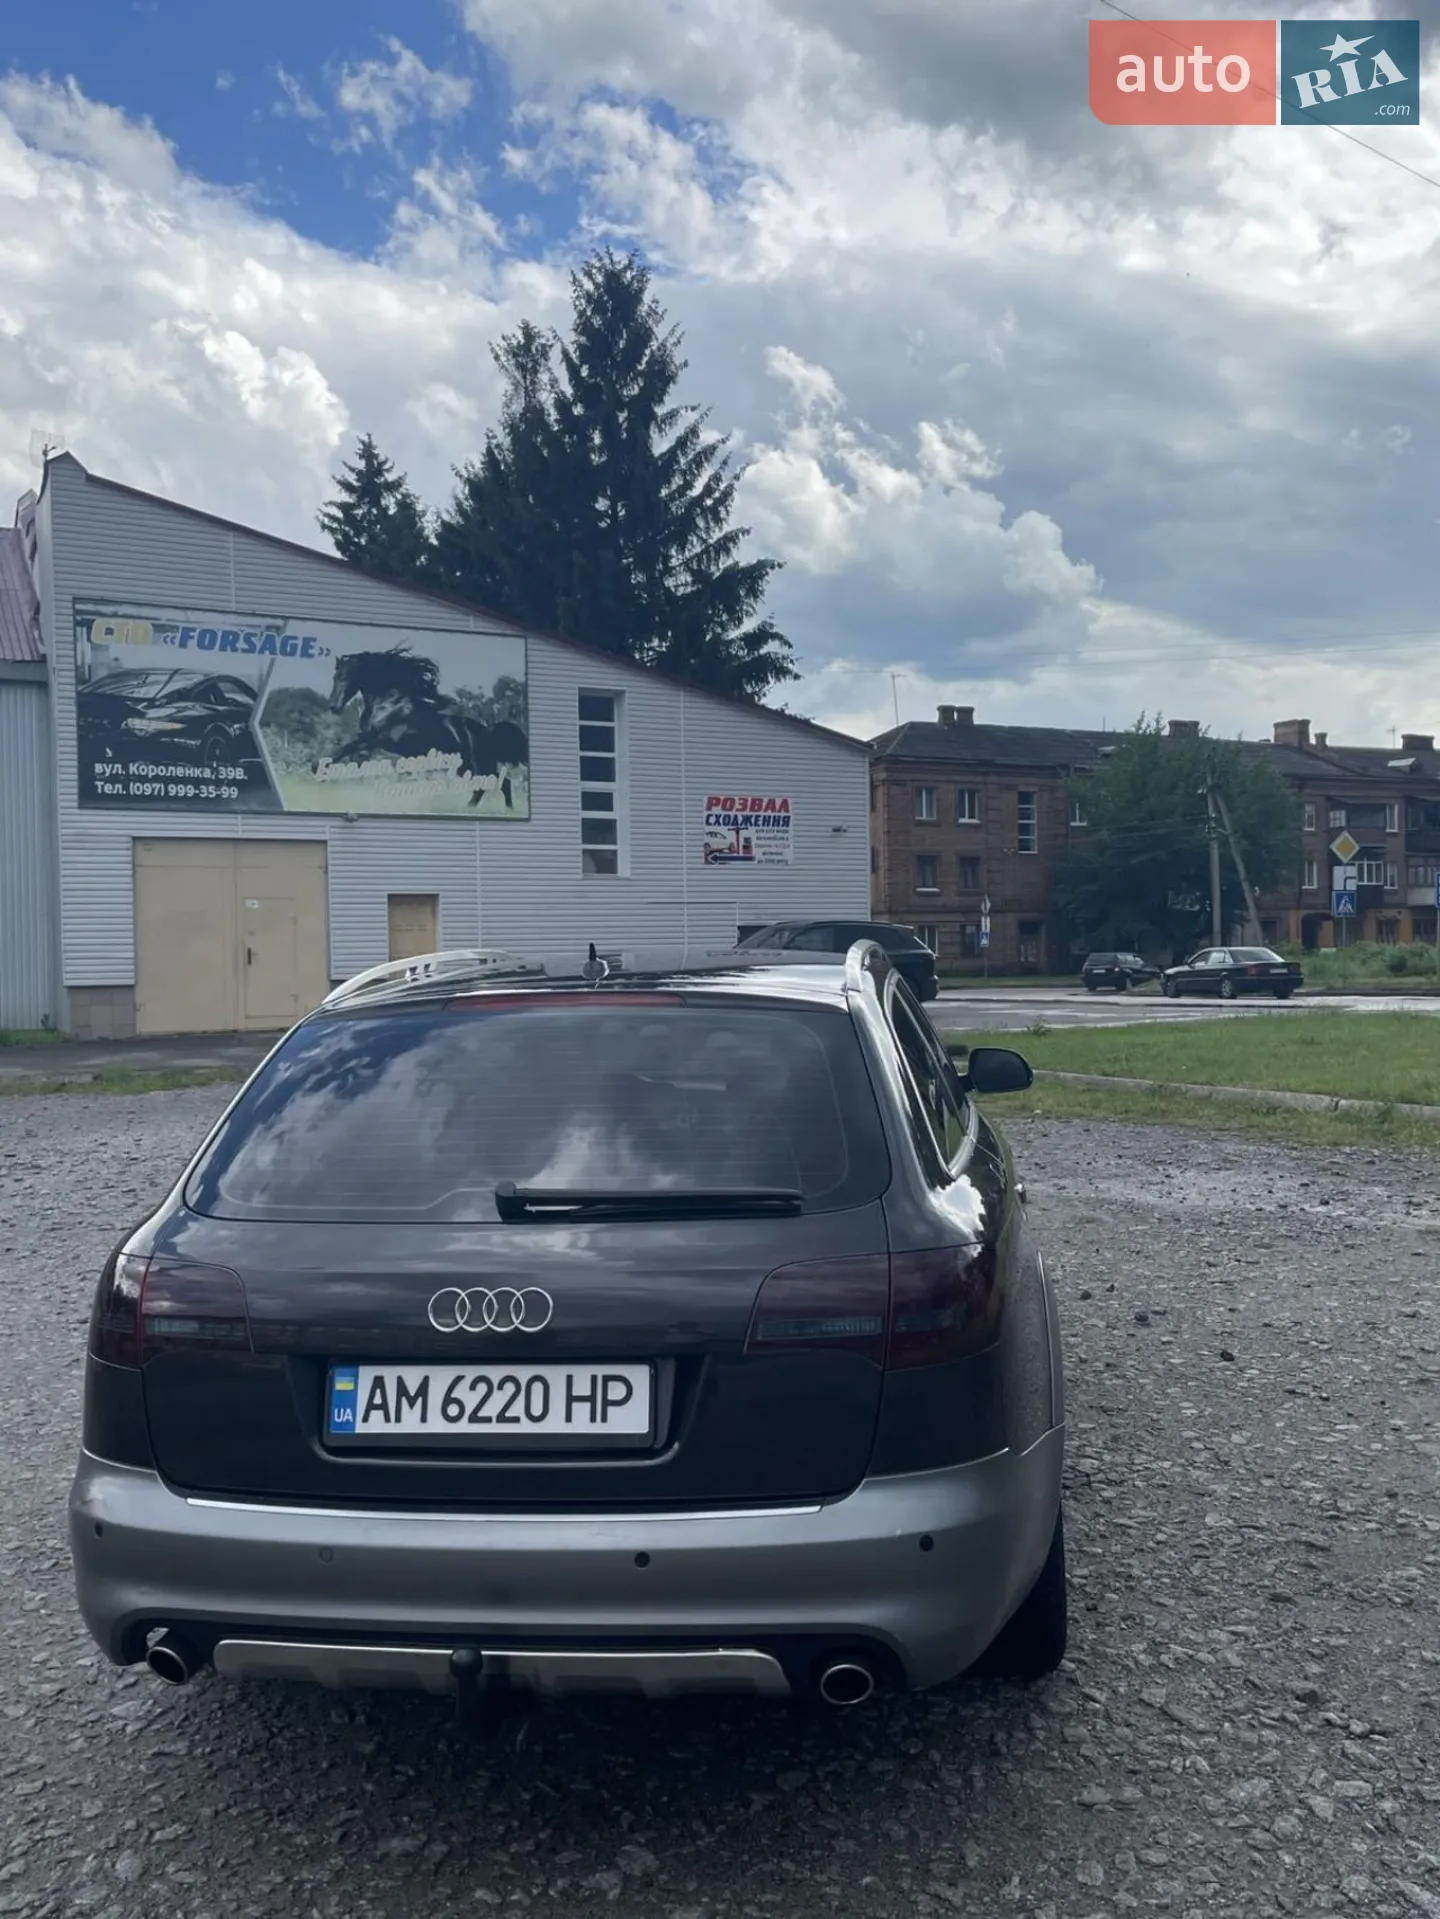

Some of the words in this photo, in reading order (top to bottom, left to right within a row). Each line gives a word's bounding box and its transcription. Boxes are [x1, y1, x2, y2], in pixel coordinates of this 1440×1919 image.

[94, 762, 126, 777] вул.
[94, 781, 127, 795] Тел.
[129, 781, 165, 797] (097)
[167, 783, 239, 799] 999-35-99
[705, 796, 790, 813] РОЗВАЛ
[705, 813, 791, 828] СХОДЖЕННЯ
[361, 1374, 431, 1424] AM
[440, 1374, 551, 1424] 6220
[565, 1374, 634, 1424] HP
[334, 1407, 354, 1423] UA
